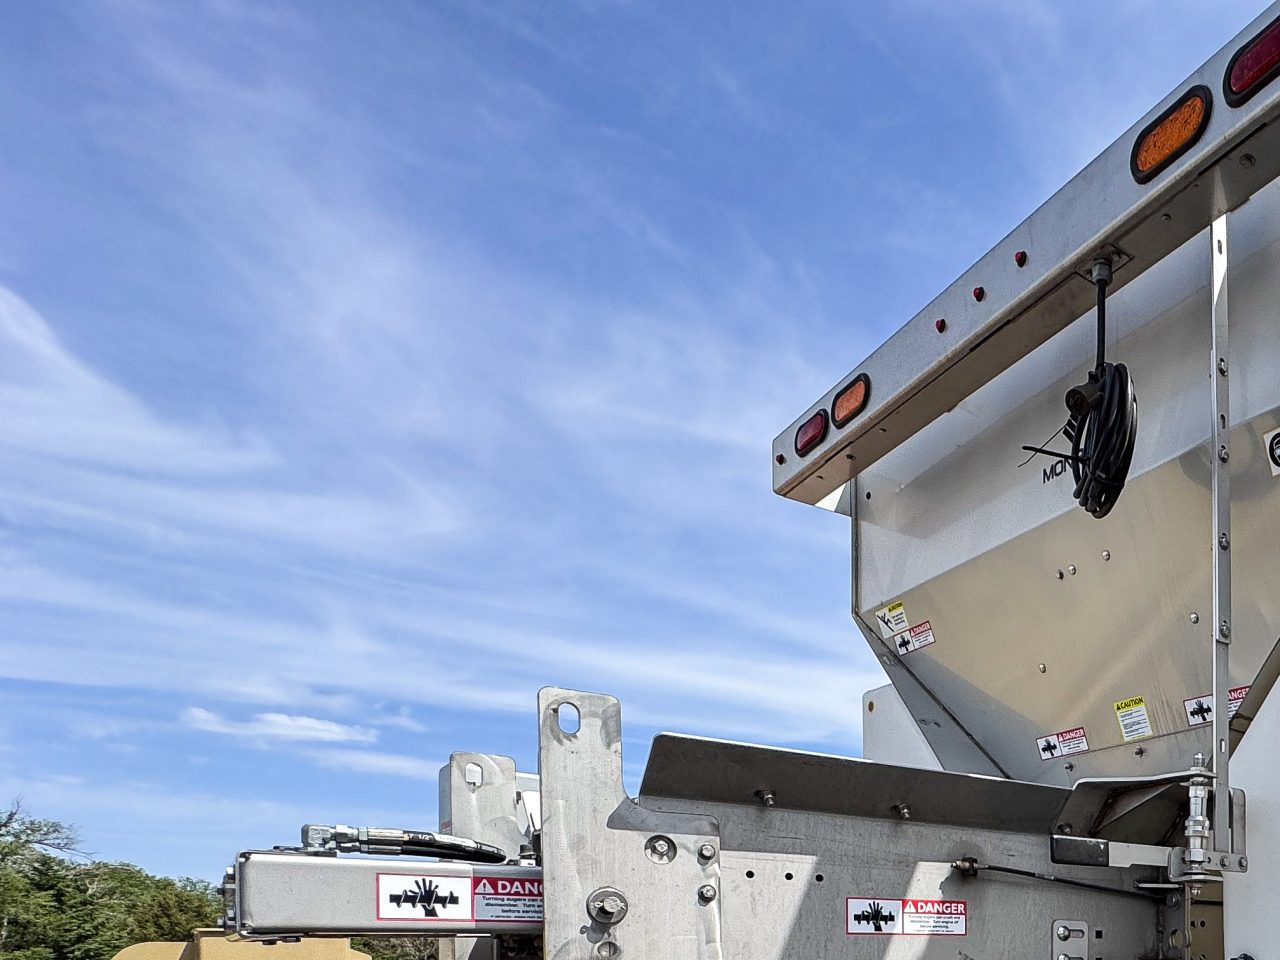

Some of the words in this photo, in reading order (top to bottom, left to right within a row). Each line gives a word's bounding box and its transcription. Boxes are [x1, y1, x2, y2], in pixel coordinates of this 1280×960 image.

[1120, 696, 1144, 710] CAUTION
[1062, 728, 1084, 740] DANGER
[917, 901, 966, 914] DANGER
